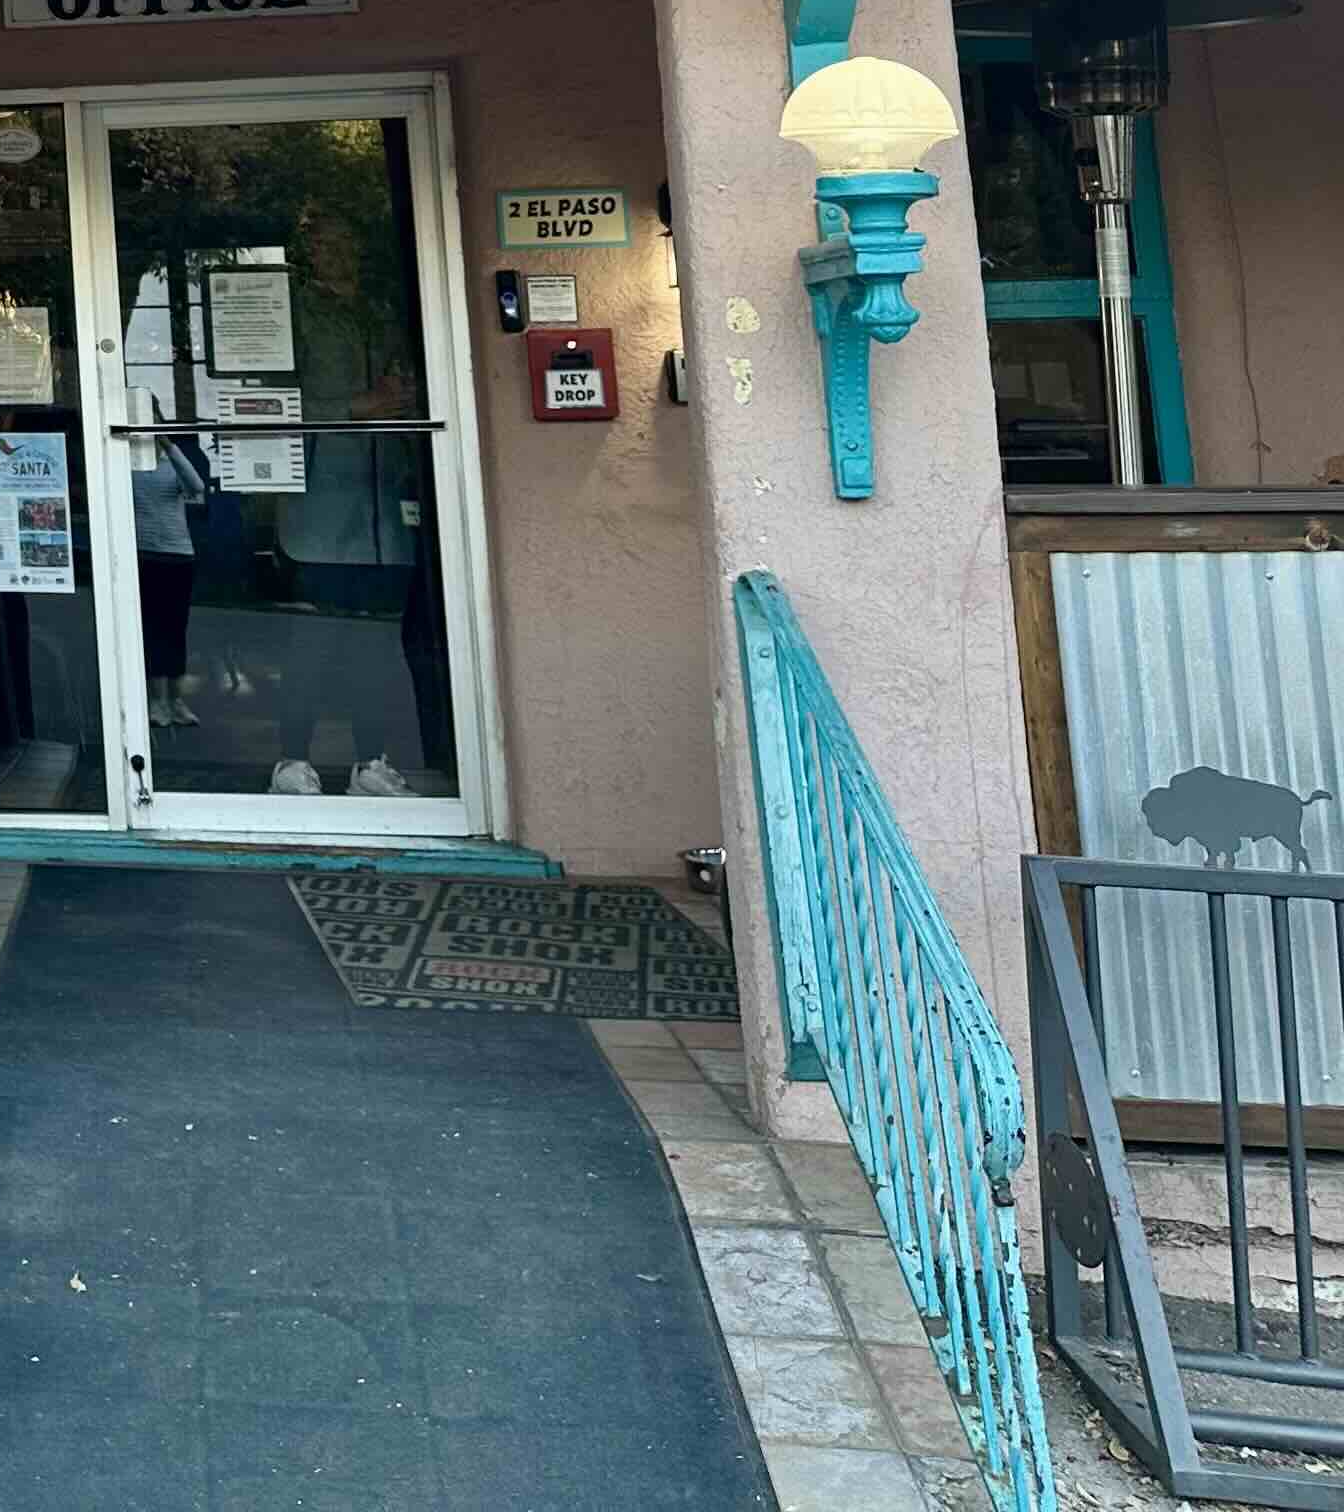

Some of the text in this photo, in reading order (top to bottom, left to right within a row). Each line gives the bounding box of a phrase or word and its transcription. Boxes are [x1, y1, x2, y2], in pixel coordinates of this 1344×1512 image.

[508, 196, 616, 218] 2 EL PASO
[536, 219, 593, 238] BLVD
[559, 374, 588, 386] KEY
[554, 390, 596, 402] DROP
[12, 462, 50, 476] SANTA
[455, 915, 617, 945] ROCK
[447, 934, 615, 966] SHOX
[428, 976, 538, 996] SHOX
